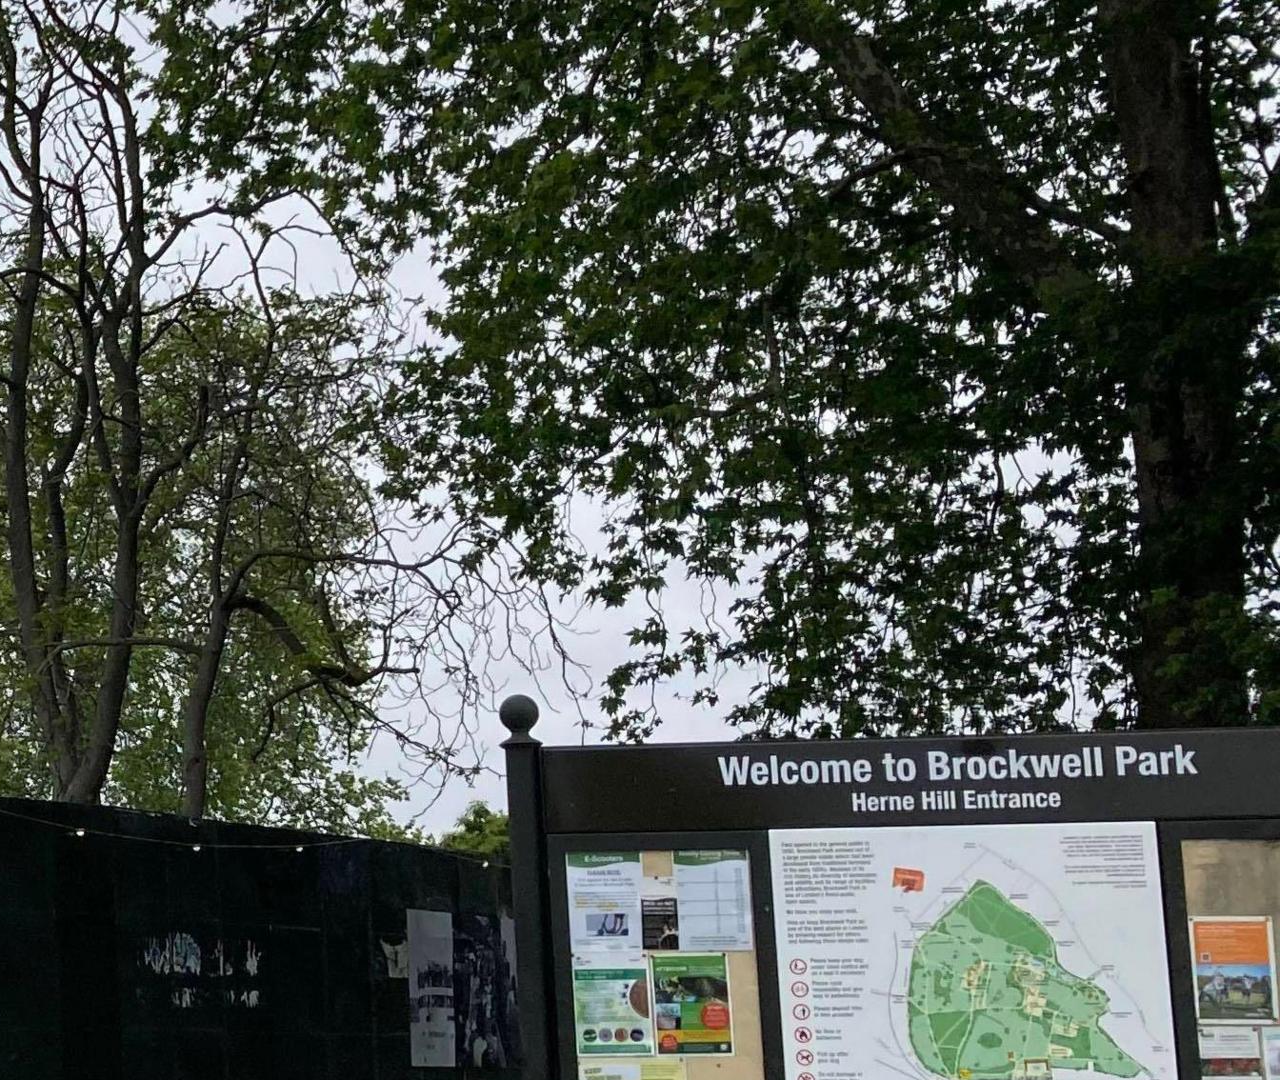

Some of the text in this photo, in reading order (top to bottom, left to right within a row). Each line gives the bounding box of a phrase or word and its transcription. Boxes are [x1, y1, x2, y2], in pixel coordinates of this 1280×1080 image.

[717, 744, 1198, 786] Welcome to Brockwell Park
[851, 789, 1061, 812] Herne Hill Entrance
